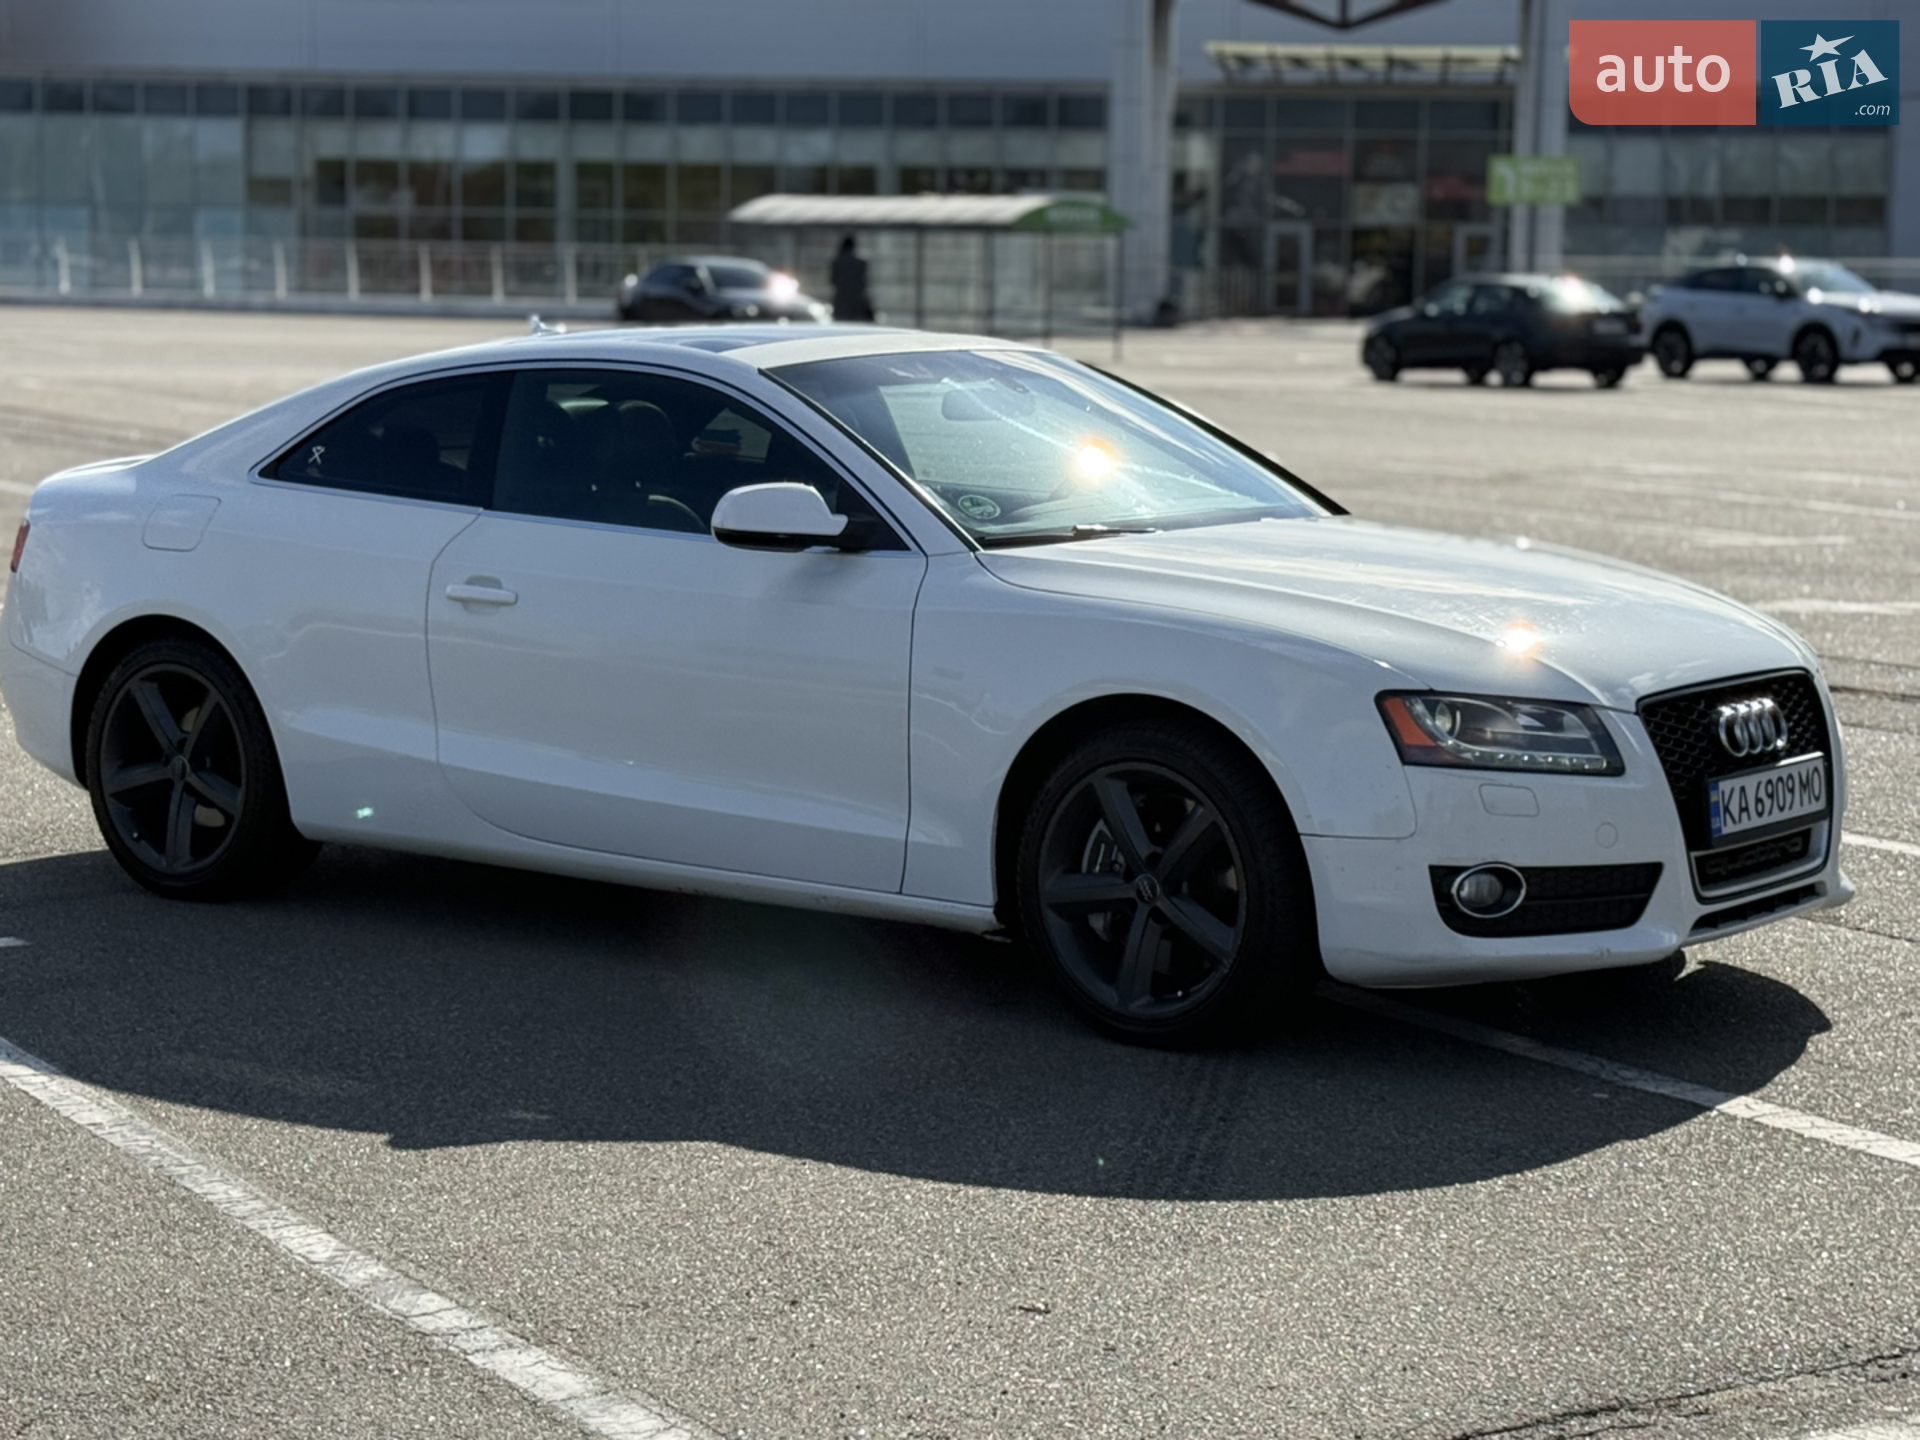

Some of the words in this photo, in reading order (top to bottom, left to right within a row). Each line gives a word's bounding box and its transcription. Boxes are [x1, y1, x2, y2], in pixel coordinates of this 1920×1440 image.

[1721, 785, 1752, 827] KA
[1754, 773, 1796, 818] 6909
[1798, 766, 1822, 807] MO
